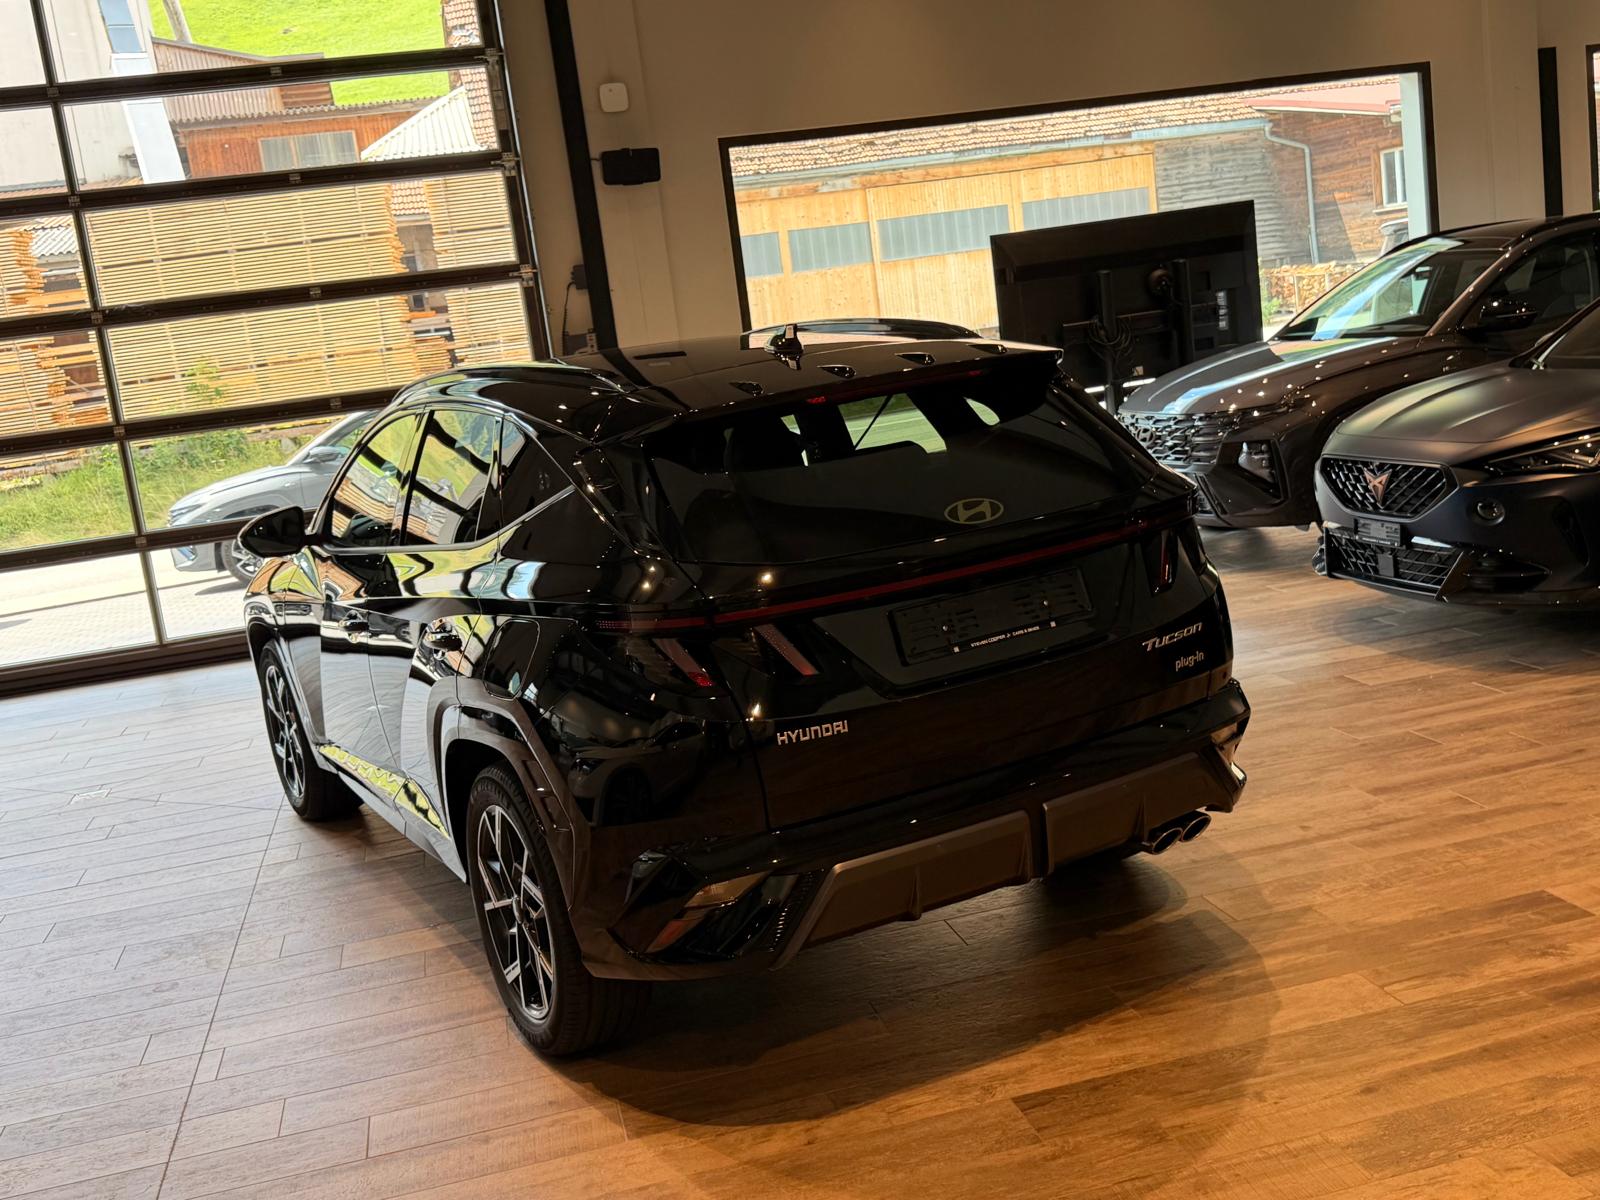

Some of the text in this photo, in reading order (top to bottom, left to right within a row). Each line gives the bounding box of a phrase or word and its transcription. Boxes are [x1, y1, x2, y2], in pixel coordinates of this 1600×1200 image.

[988, 634, 1005, 643] COOPER
[1142, 621, 1203, 652] TUCSON
[777, 719, 849, 746] HYUNDAI
